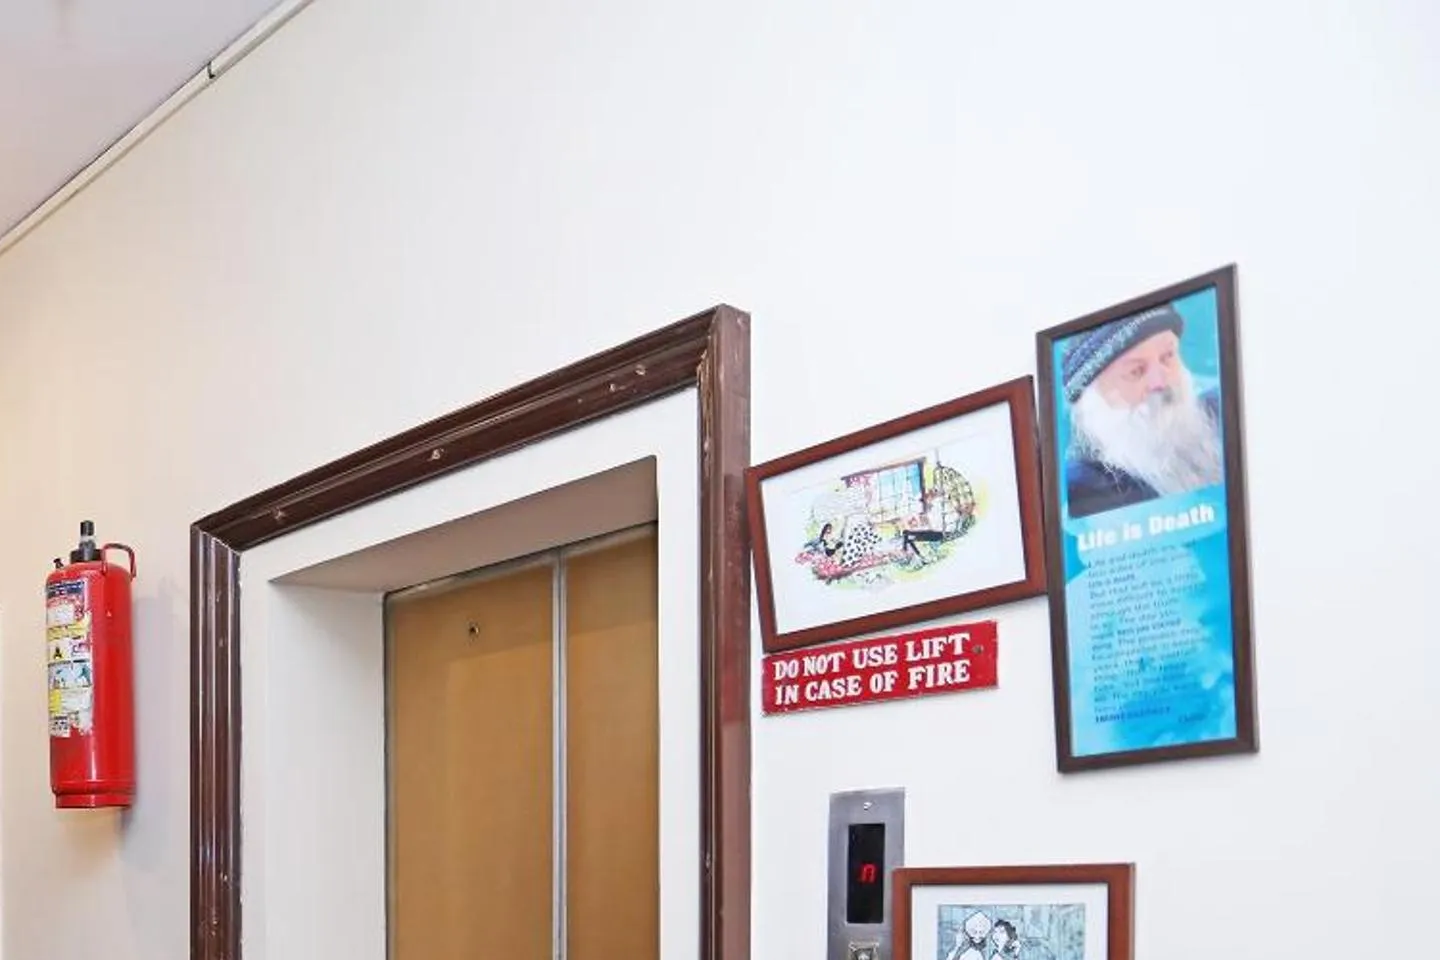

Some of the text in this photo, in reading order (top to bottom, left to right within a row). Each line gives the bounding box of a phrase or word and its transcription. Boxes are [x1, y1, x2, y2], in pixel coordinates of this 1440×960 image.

[1077, 504, 1215, 551] Life is Death
[772, 633, 970, 680] DO NOT USE LIFT
[775, 660, 971, 705] IN CASE OF FIRE
